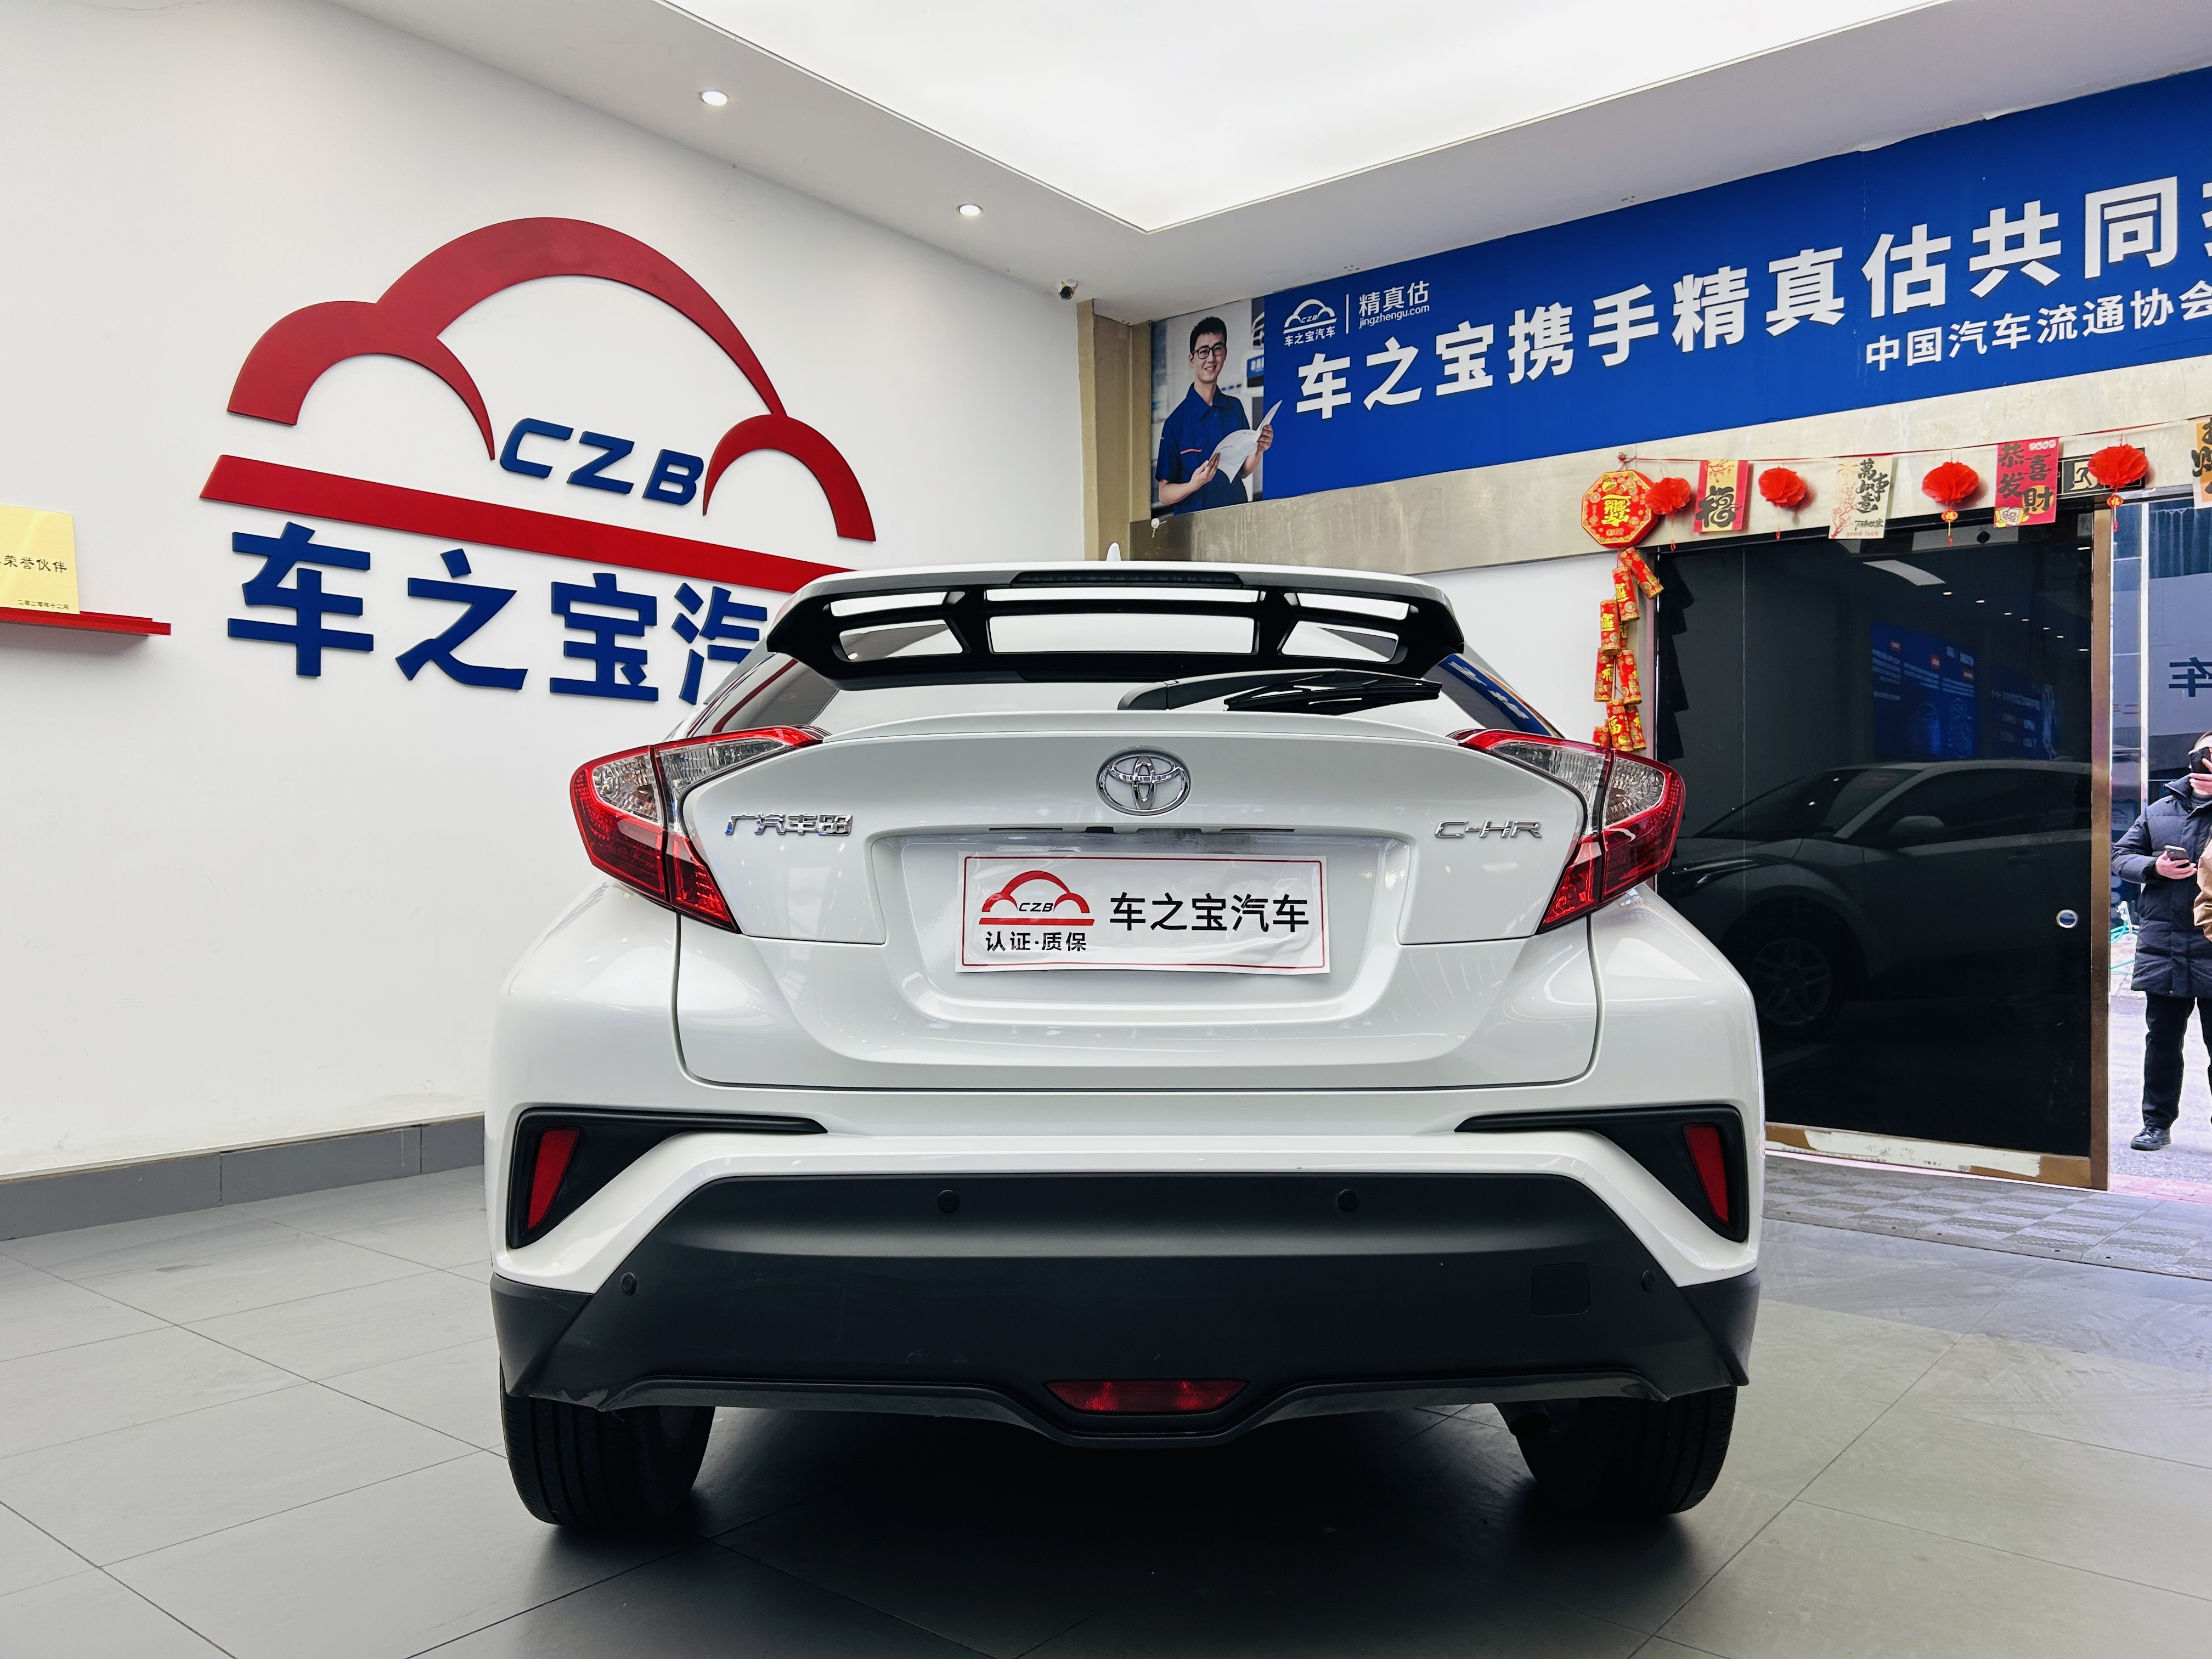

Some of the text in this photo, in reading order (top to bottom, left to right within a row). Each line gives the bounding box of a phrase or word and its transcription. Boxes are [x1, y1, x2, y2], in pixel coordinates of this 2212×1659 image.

[1296, 176, 2212, 420] 车之宝携手精真估共同
[1358, 280, 1430, 317] 精真估
[1301, 314, 1317, 323] CZB
[1358, 304, 1430, 329] jingzhengu.com
[1866, 280, 2212, 371] 中国汽车流通协会
[1284, 326, 1335, 346] 车之宝汽车
[499, 417, 704, 506] CZB
[0, 555, 67, 573] 荣誉伙伴
[1434, 820, 1542, 838] C-HR
[1018, 902, 1054, 912] CZB
[1109, 891, 1310, 933] 车之宝汽车
